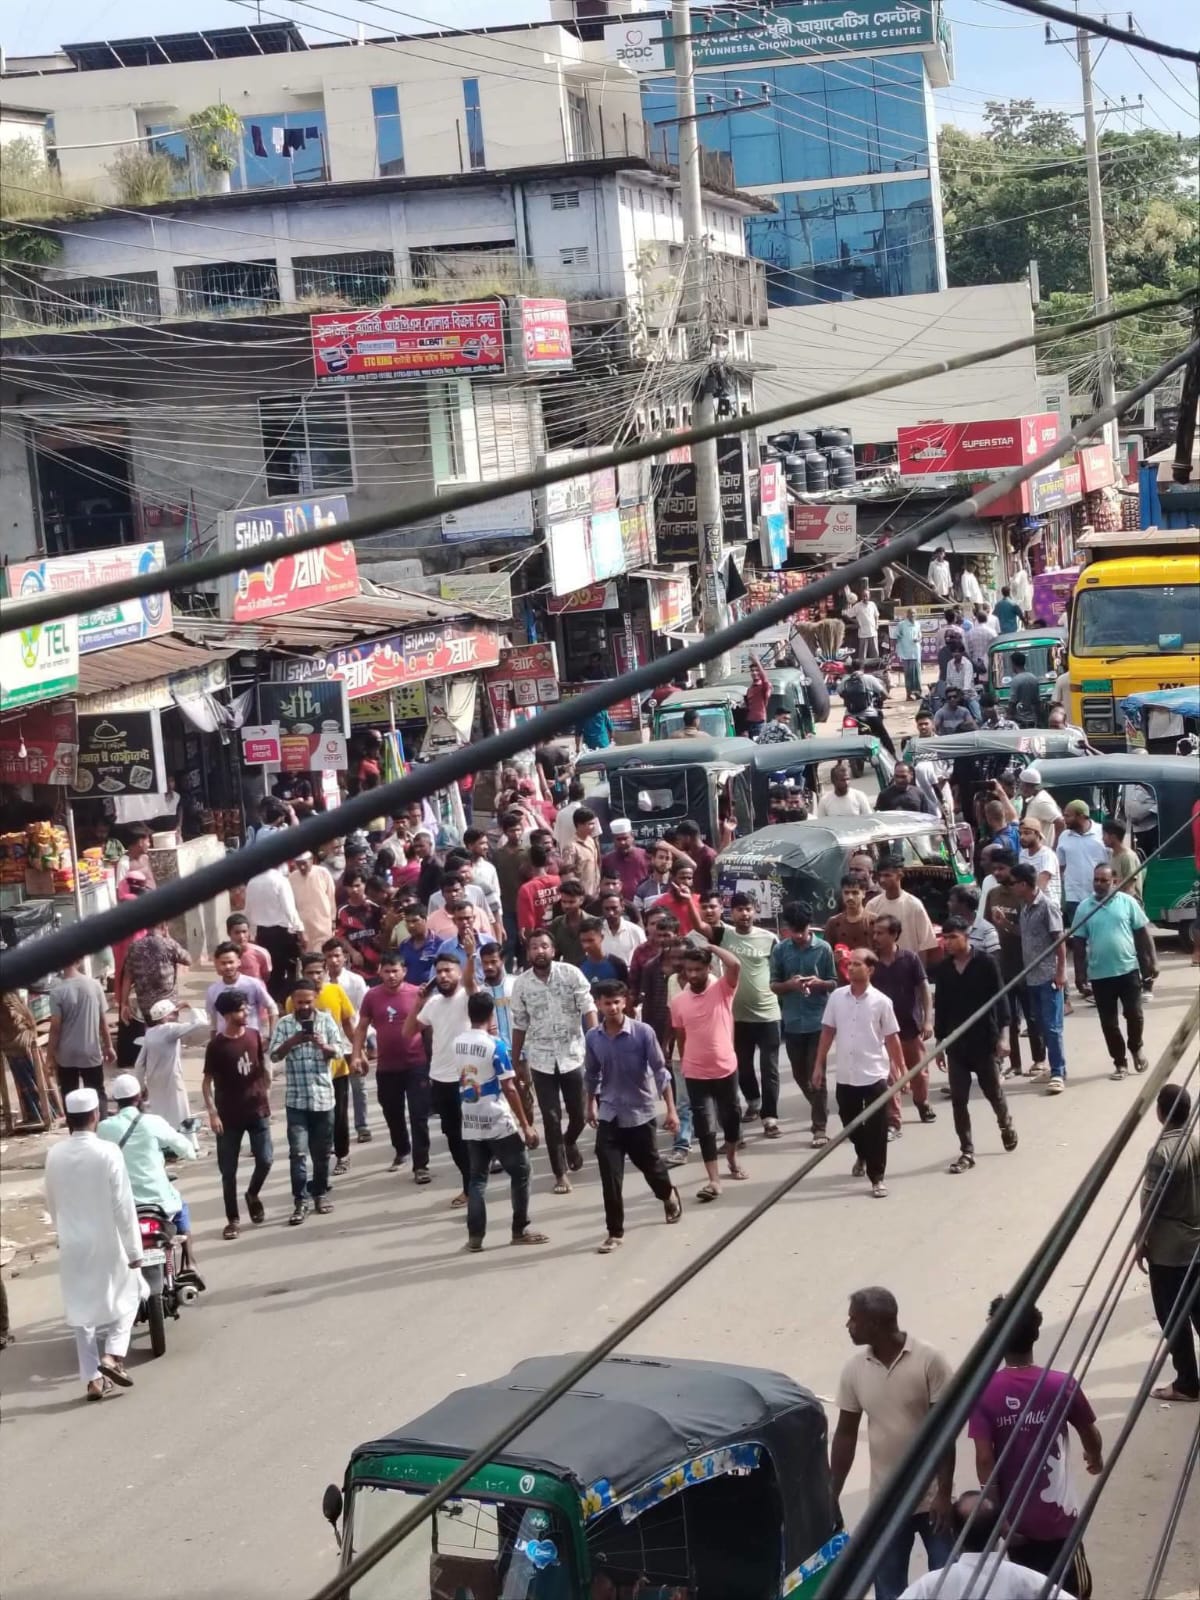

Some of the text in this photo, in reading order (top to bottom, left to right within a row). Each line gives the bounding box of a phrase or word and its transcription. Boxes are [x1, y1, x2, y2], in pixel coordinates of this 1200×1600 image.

[873, 6, 921, 26] সেন্টার
[758, 37, 822, 51] CHOWDHURY
[826, 30, 877, 43] DIABETES
[881, 26, 922, 37] CENTRE
[962, 436, 1014, 448] SUPER STAR
[235, 520, 274, 551] SHAAD
[405, 631, 437, 650] SHAAD
[287, 658, 326, 681] SHAAD
